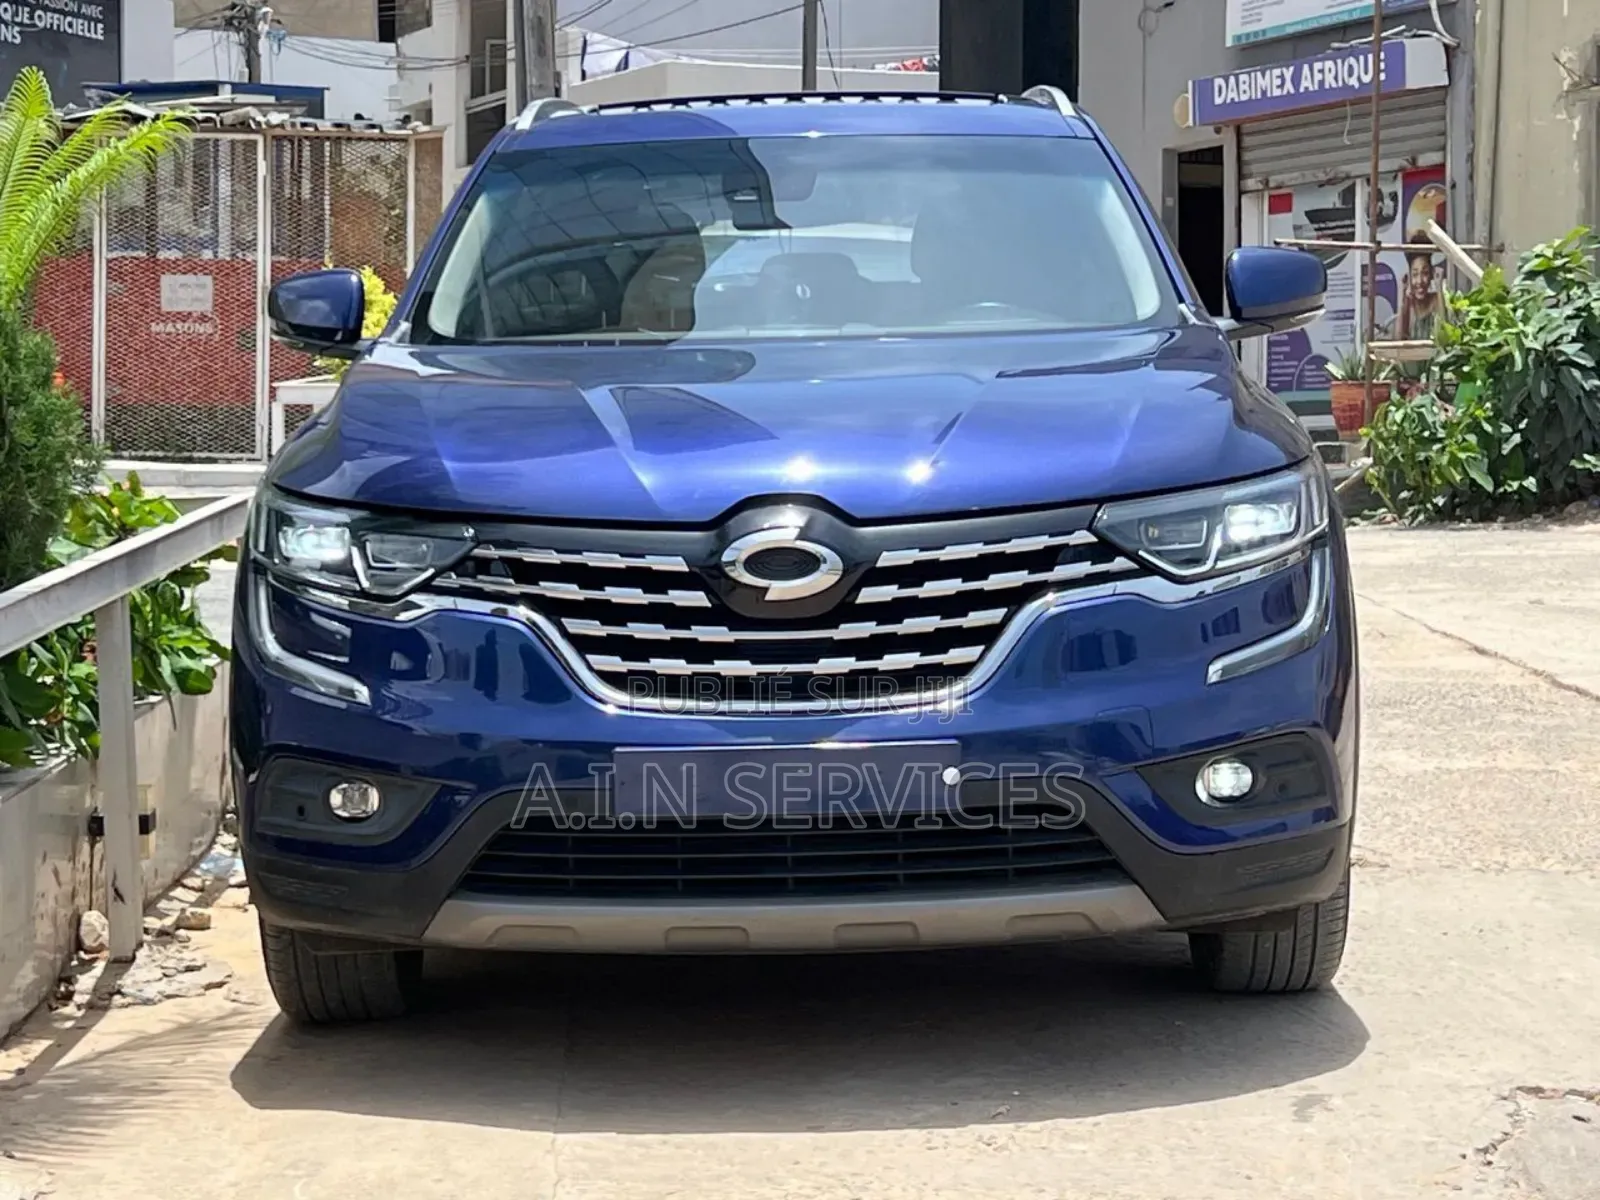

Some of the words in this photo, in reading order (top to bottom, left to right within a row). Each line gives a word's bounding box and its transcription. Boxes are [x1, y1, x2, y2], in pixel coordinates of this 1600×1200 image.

[34, 10, 104, 40] OFFICIELLE
[80, 4, 104, 19] AVEC
[1213, 66, 1295, 105] DABIMEX
